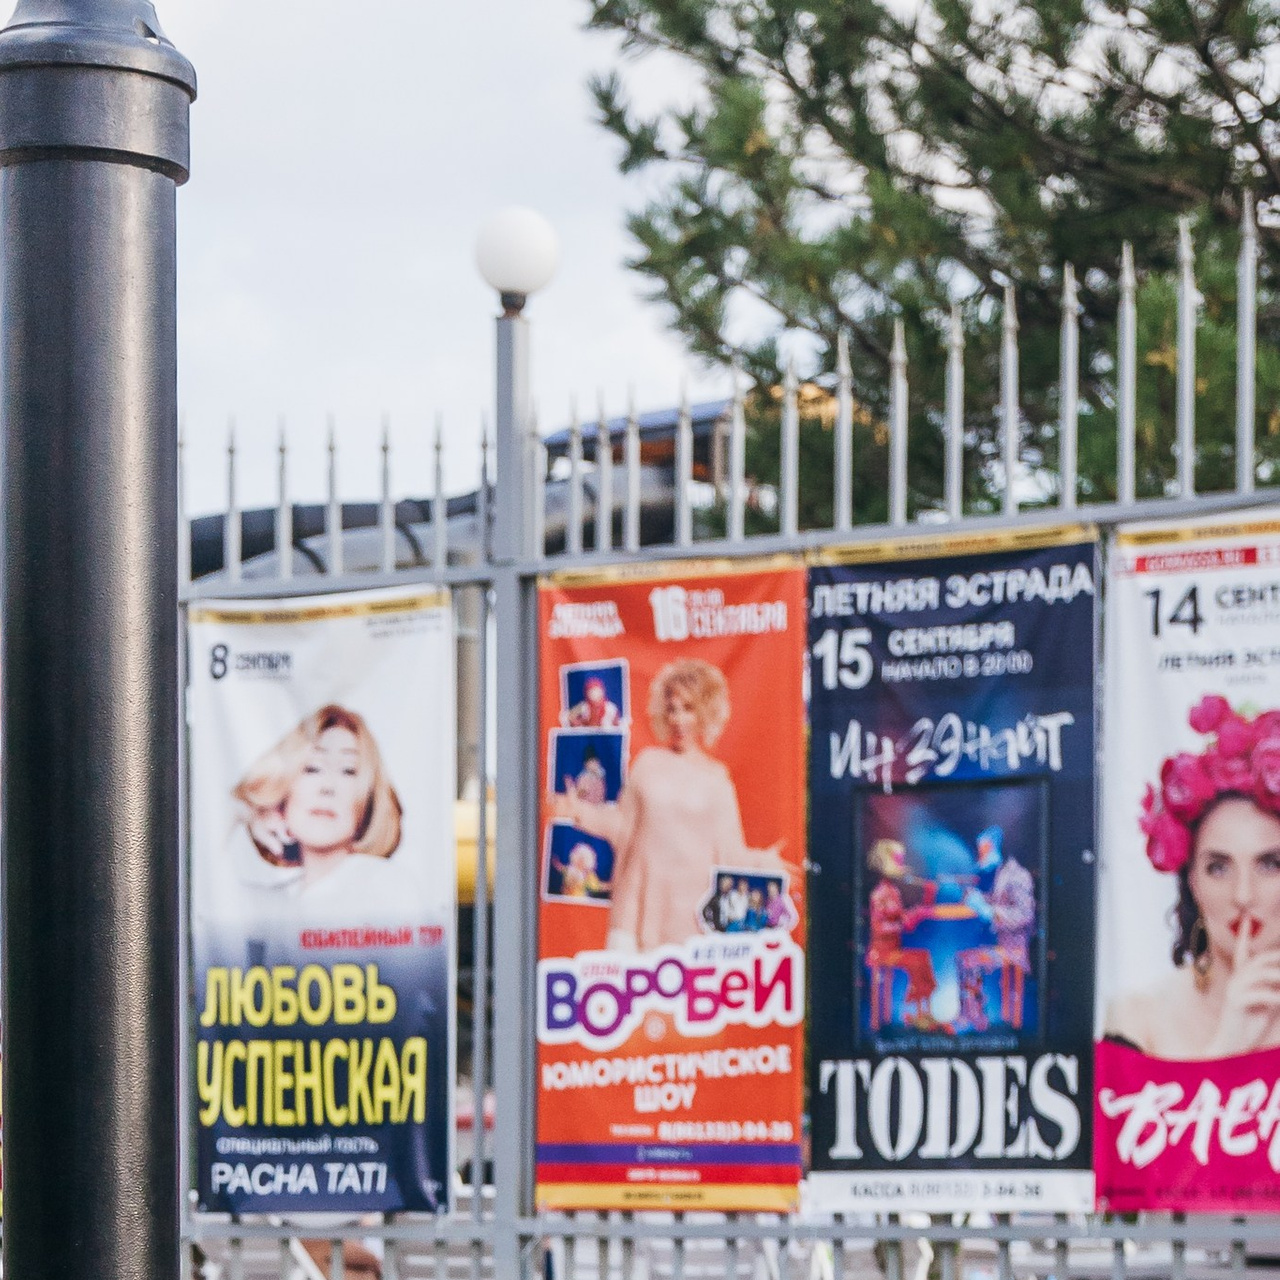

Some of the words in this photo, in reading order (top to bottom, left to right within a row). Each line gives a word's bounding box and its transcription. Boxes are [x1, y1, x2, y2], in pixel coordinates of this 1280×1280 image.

[648, 584, 689, 642] 16
[811, 576, 941, 618] ЛЕТНЯЯ
[944, 562, 1095, 609] ЭСТРАДА
[1144, 582, 1205, 638] 14
[210, 643, 228, 680] 8
[813, 627, 874, 690] 15
[887, 620, 1016, 657] СЕНТЯБРЯ
[200, 963, 398, 1027] ЛЮБОВЬ
[197, 1036, 428, 1128] УСПЕНСКАЯ
[542, 1044, 793, 1091] ЮМОРИСТИЧЕСКОЕ
[633, 1082, 696, 1112] ШОУ
[819, 1052, 1082, 1162] TODES
